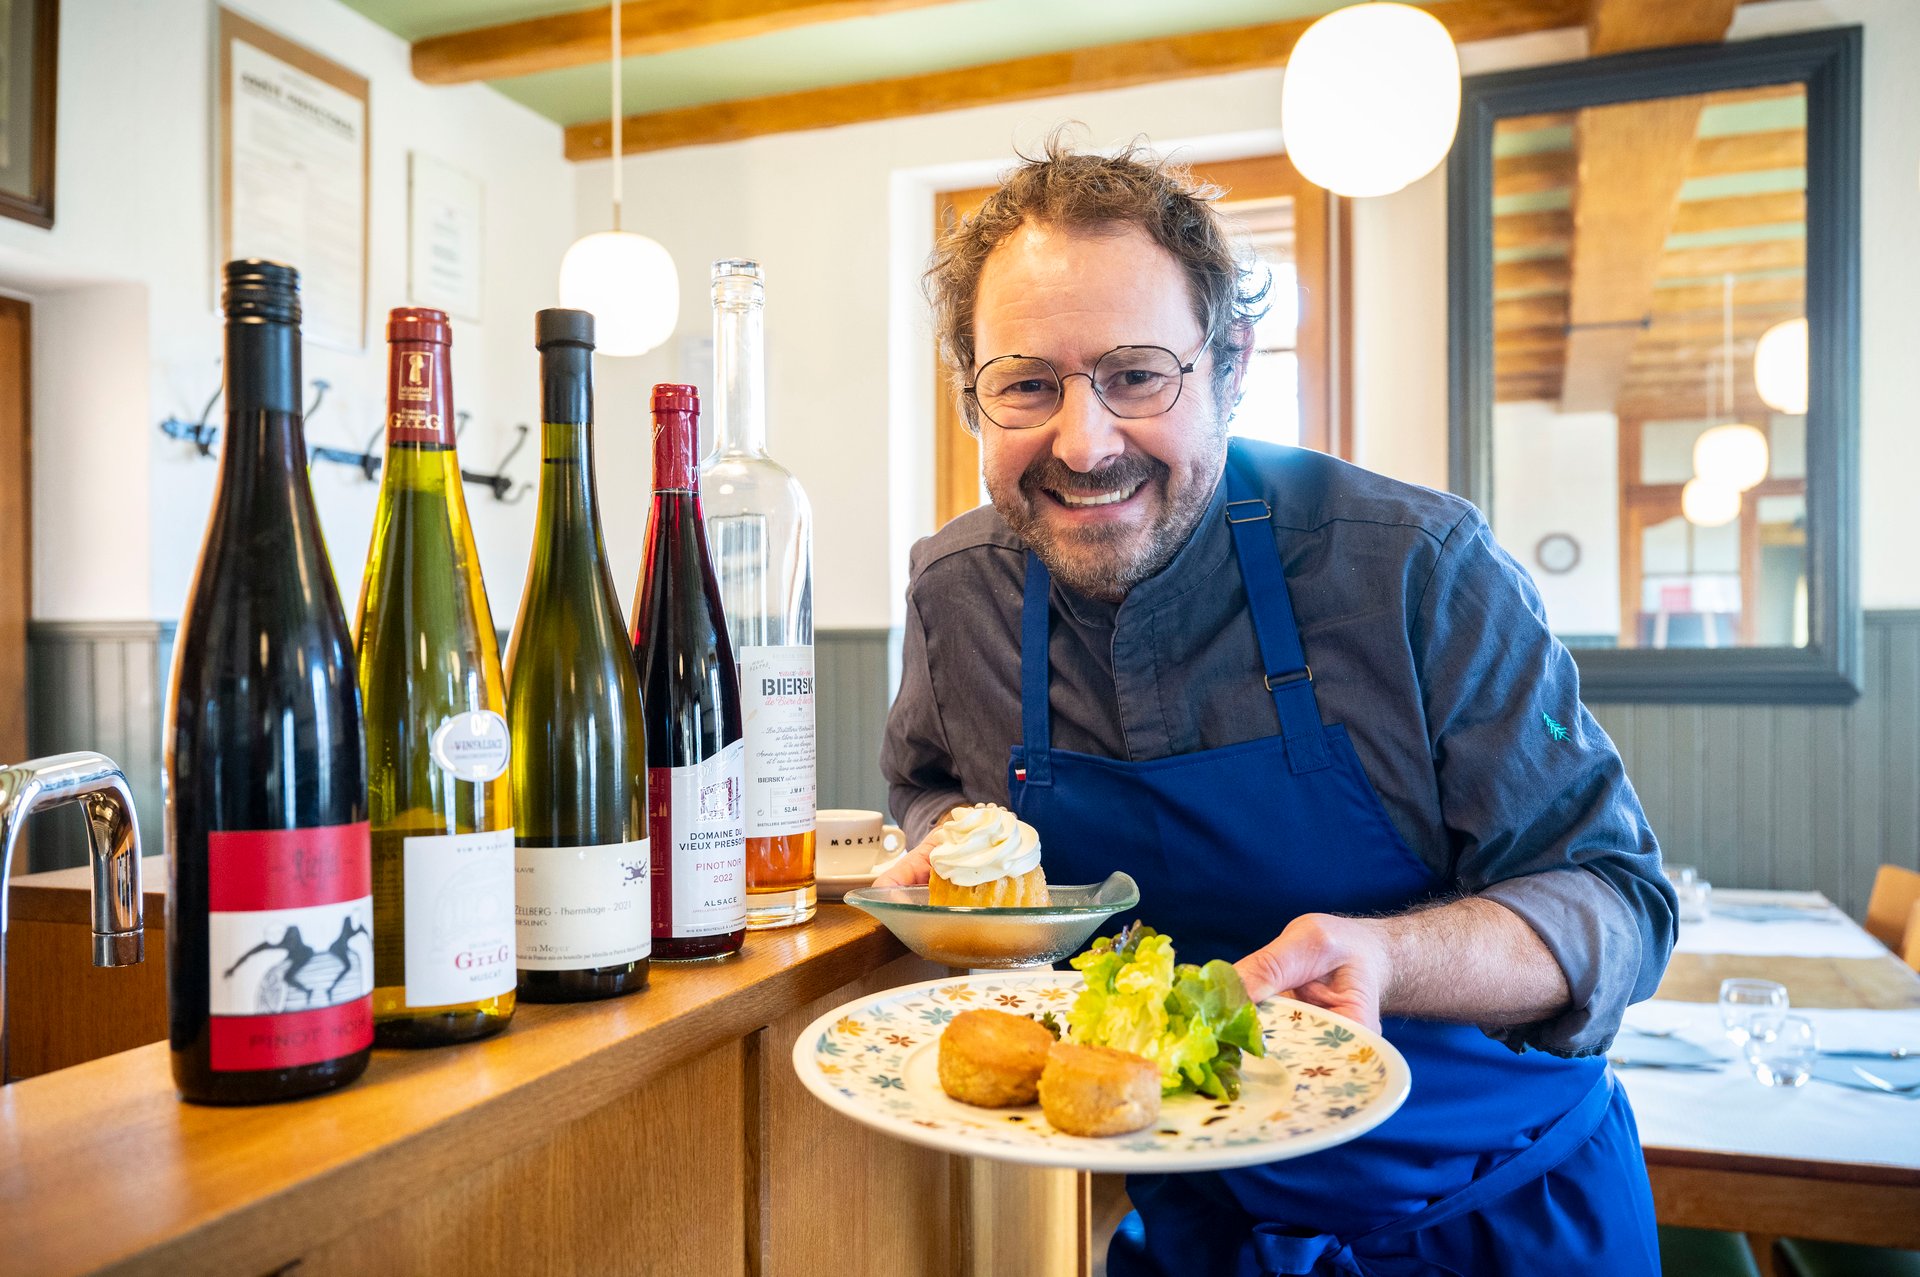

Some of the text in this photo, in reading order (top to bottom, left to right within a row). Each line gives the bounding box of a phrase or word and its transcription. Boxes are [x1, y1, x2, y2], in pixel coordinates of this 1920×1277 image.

[762, 677, 814, 696] BIERSK
[690, 827, 743, 841] DOMAINE DU
[679, 837, 745, 851] VIEUX PRESSO
[695, 860, 725, 871] PINOT
[713, 873, 733, 883] 2022
[613, 900, 632, 912] 2021
[704, 896, 737, 907] ALSACE
